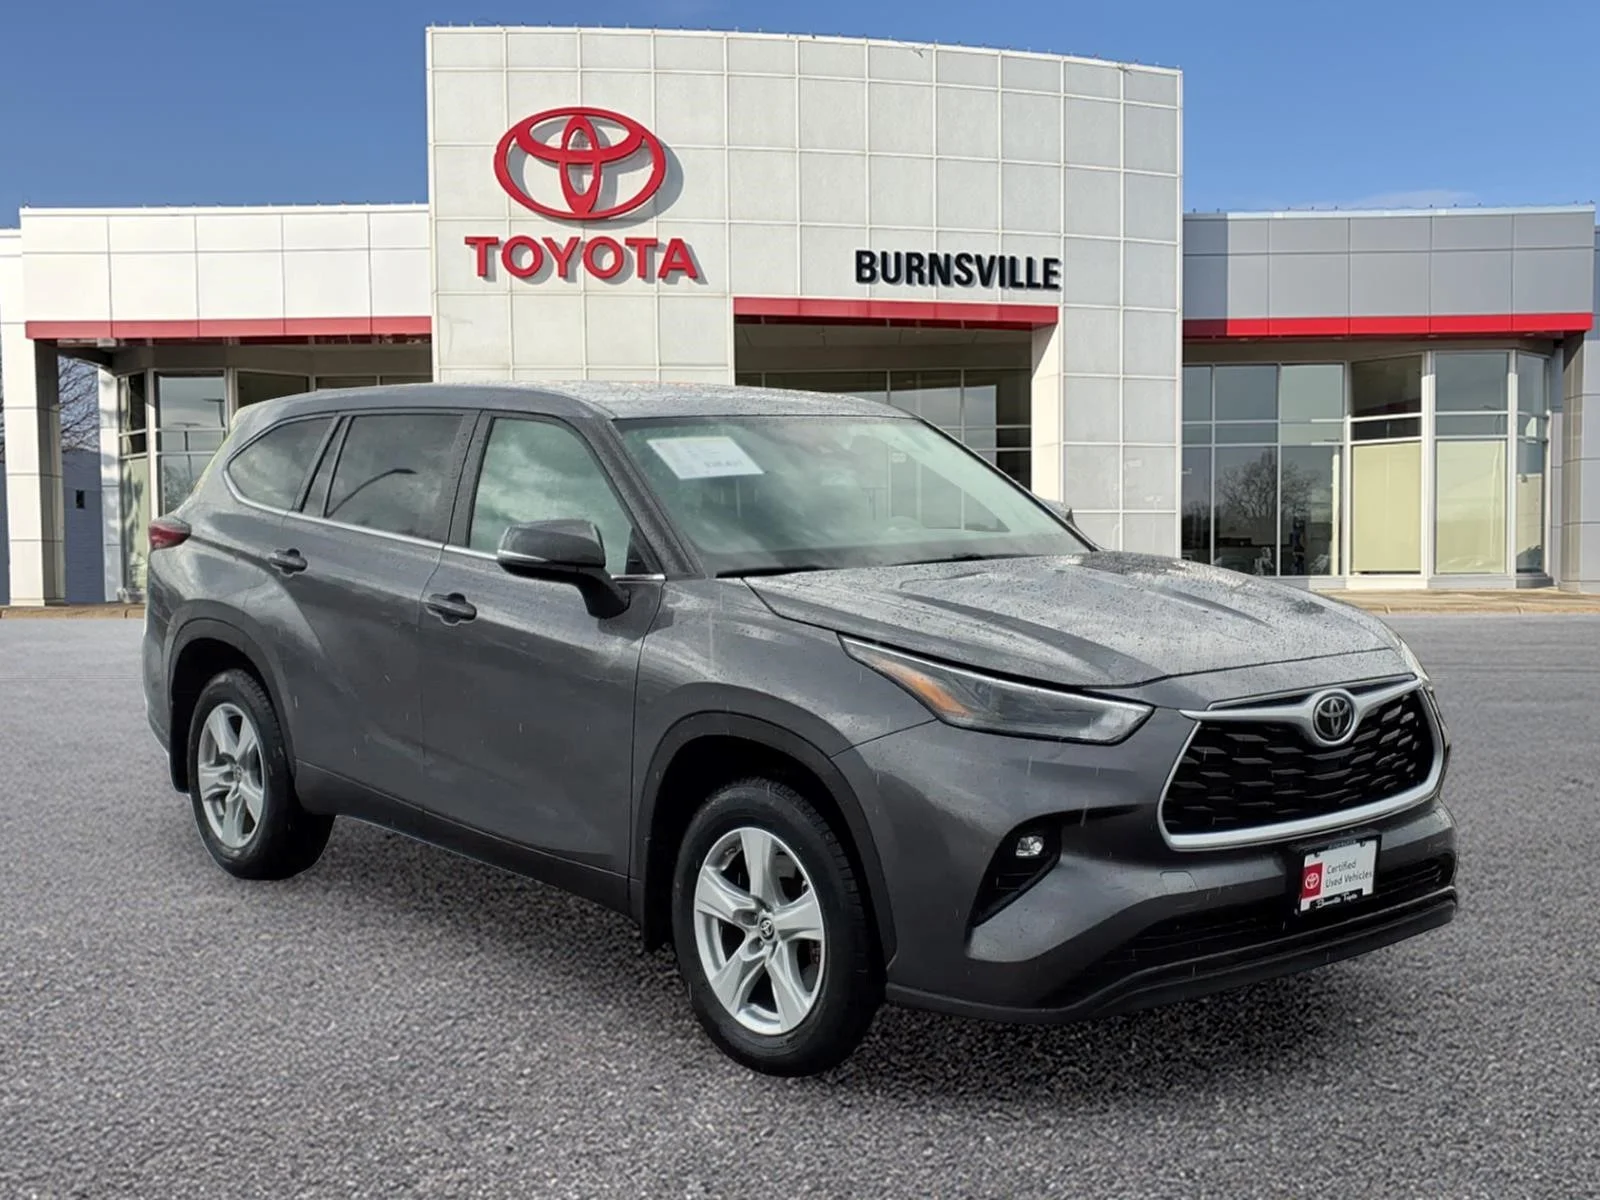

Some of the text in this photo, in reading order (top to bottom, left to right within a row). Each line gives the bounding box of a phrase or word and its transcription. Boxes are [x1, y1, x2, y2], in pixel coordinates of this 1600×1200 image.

[464, 235, 699, 280] TOYOTA
[855, 250, 1061, 290] BURNSVILLE
[1325, 870, 1373, 888] Used Vehicles
[1327, 860, 1356, 874] Certified
